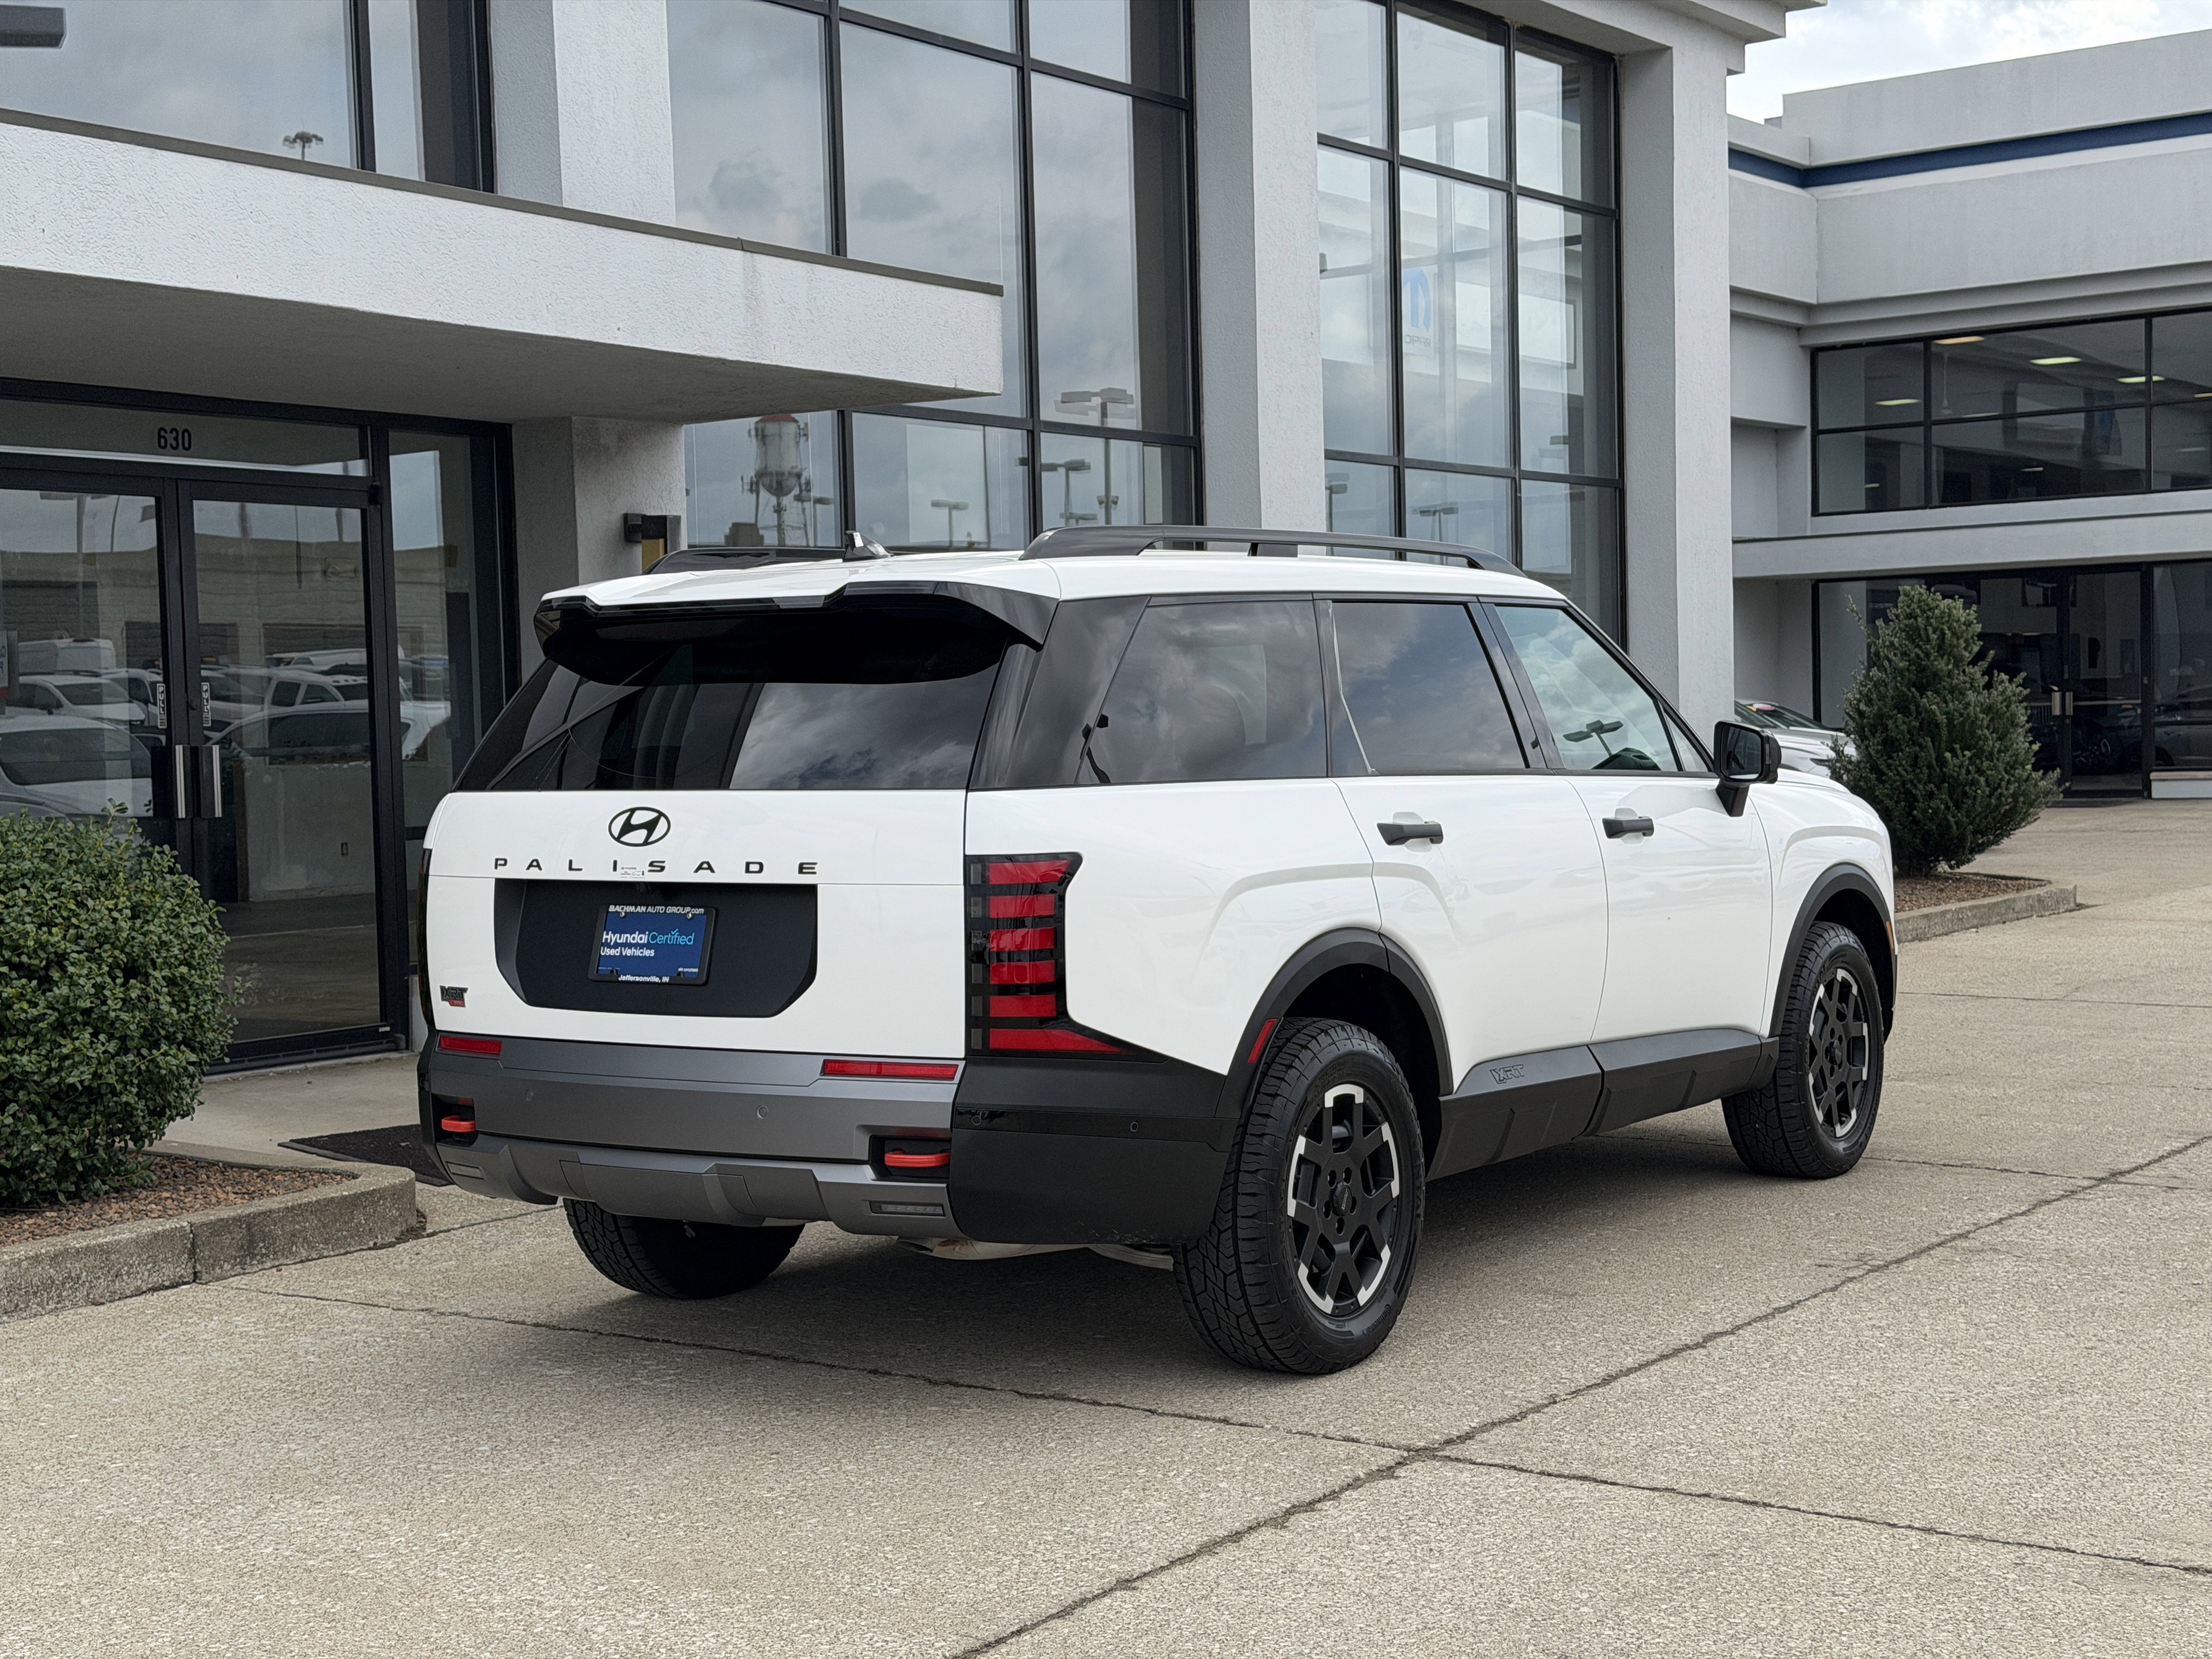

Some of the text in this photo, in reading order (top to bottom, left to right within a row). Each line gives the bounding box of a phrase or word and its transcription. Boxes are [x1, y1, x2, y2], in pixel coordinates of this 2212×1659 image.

[157, 427, 191, 451] 630
[494, 857, 819, 875] PALISADE
[608, 905, 646, 913] BACHMAN
[602, 929, 695, 945] Hyundai Certified
[600, 946, 655, 957] Used Vehicles
[618, 974, 662, 983] Jeffersonville,
[439, 985, 469, 1001] XRT
[1489, 1064, 1525, 1084] XRT
